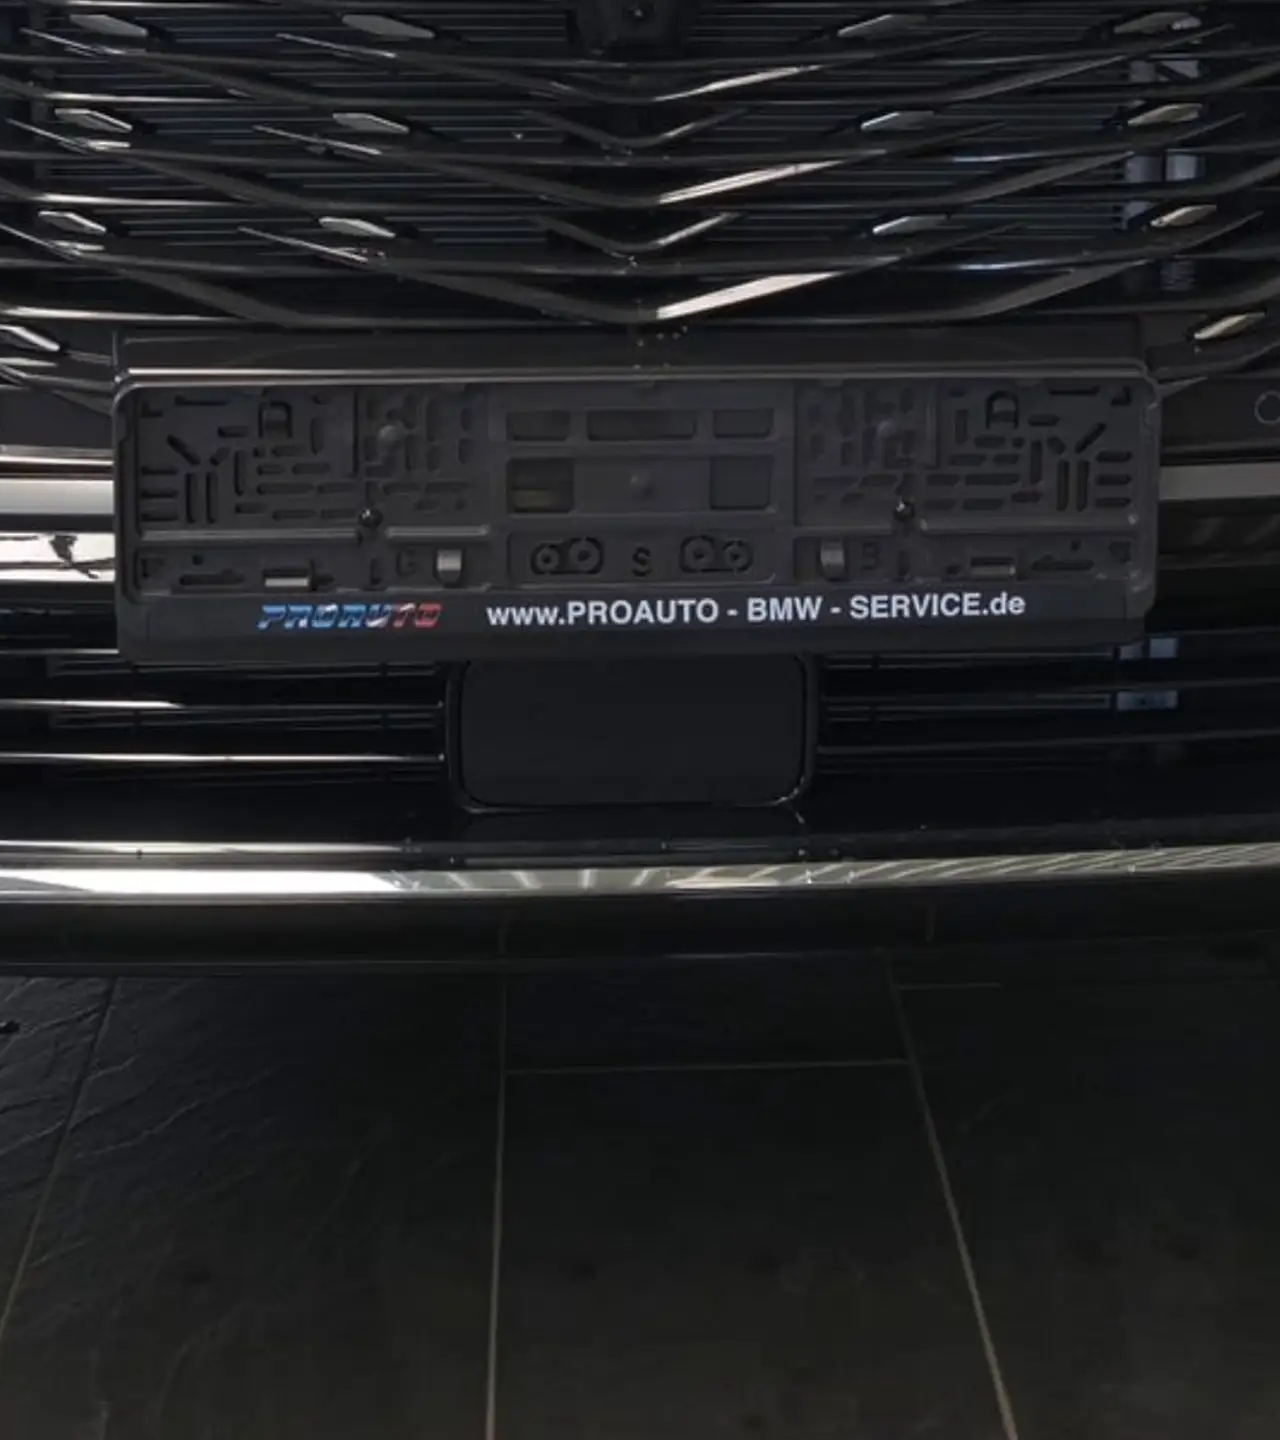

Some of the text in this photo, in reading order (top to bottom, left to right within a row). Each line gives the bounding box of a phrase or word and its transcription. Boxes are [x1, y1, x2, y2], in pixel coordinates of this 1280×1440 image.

[256, 603, 443, 630] PROAUTO
[485, 598, 719, 626] www.PROAUTO
[747, 596, 822, 623] BMW
[849, 592, 1026, 620] SERVICE.de
